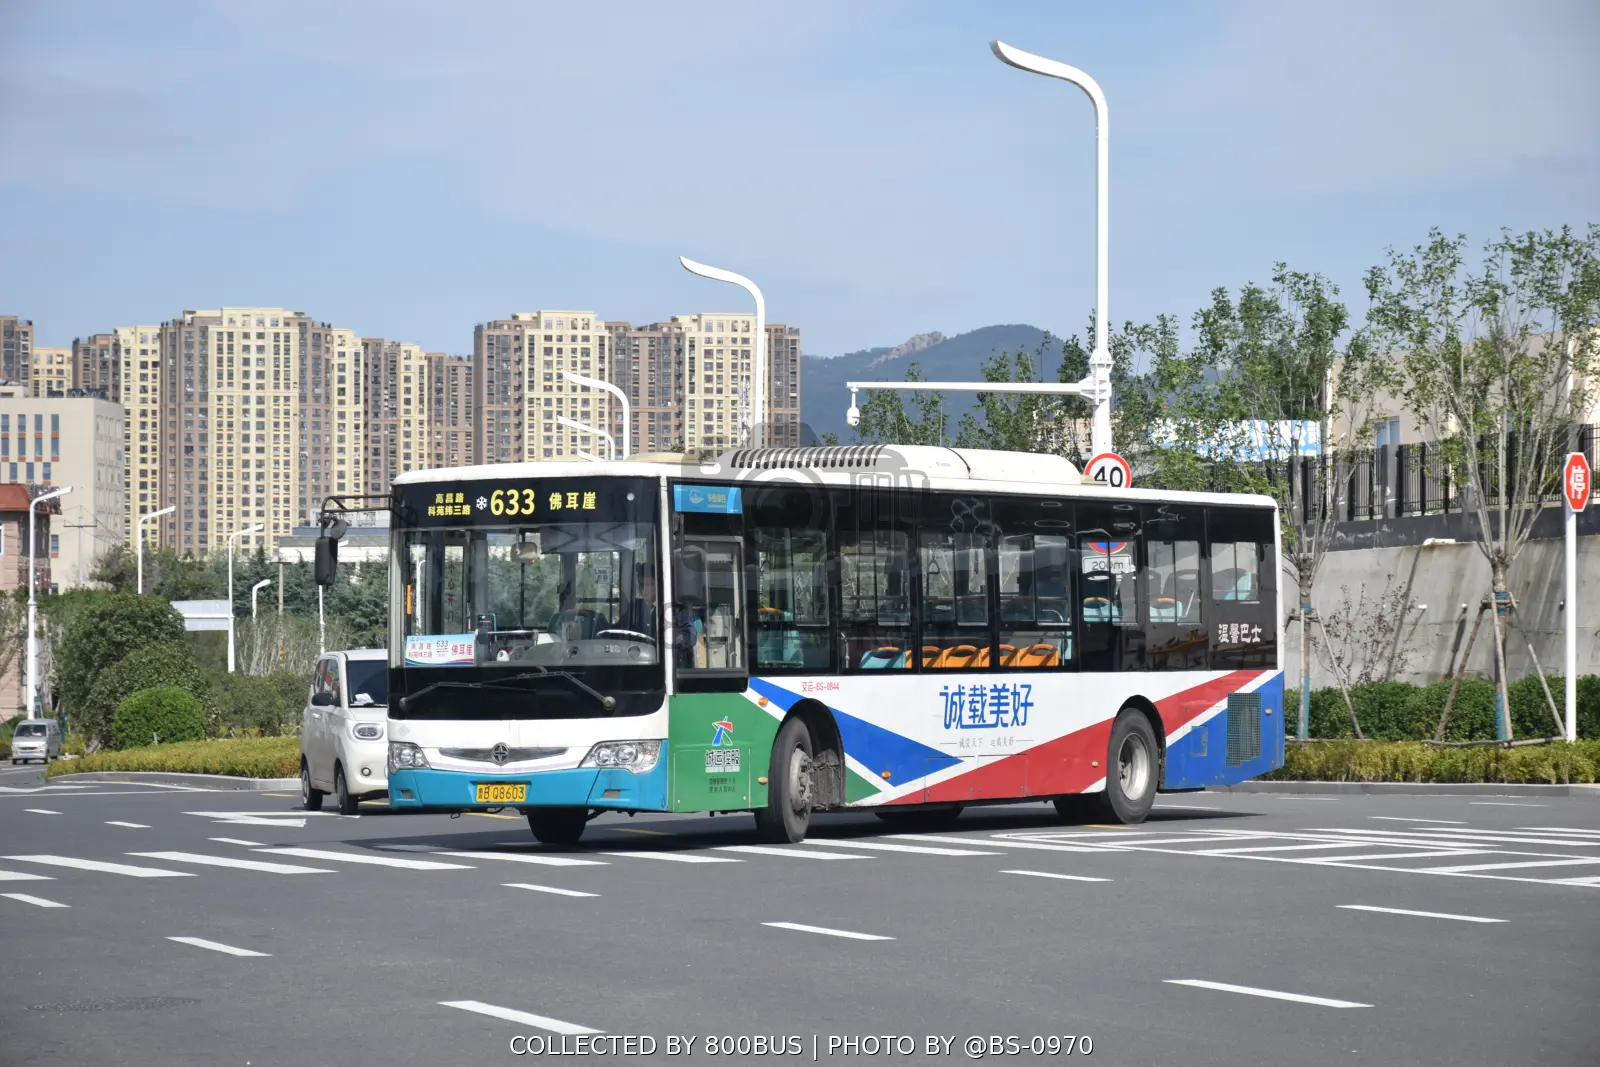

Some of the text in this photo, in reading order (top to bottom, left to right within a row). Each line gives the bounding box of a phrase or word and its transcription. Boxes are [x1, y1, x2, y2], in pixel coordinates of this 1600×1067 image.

[1094, 466, 1123, 488] 40
[1569, 465, 1586, 499] 停
[435, 492, 465, 504] 高昌路
[490, 489, 535, 516] 633
[549, 492, 596, 510] 佛耳崖
[427, 504, 471, 517] 科苑纬三路
[436, 640, 449, 648] 633
[939, 683, 1034, 730] 诚载美好
